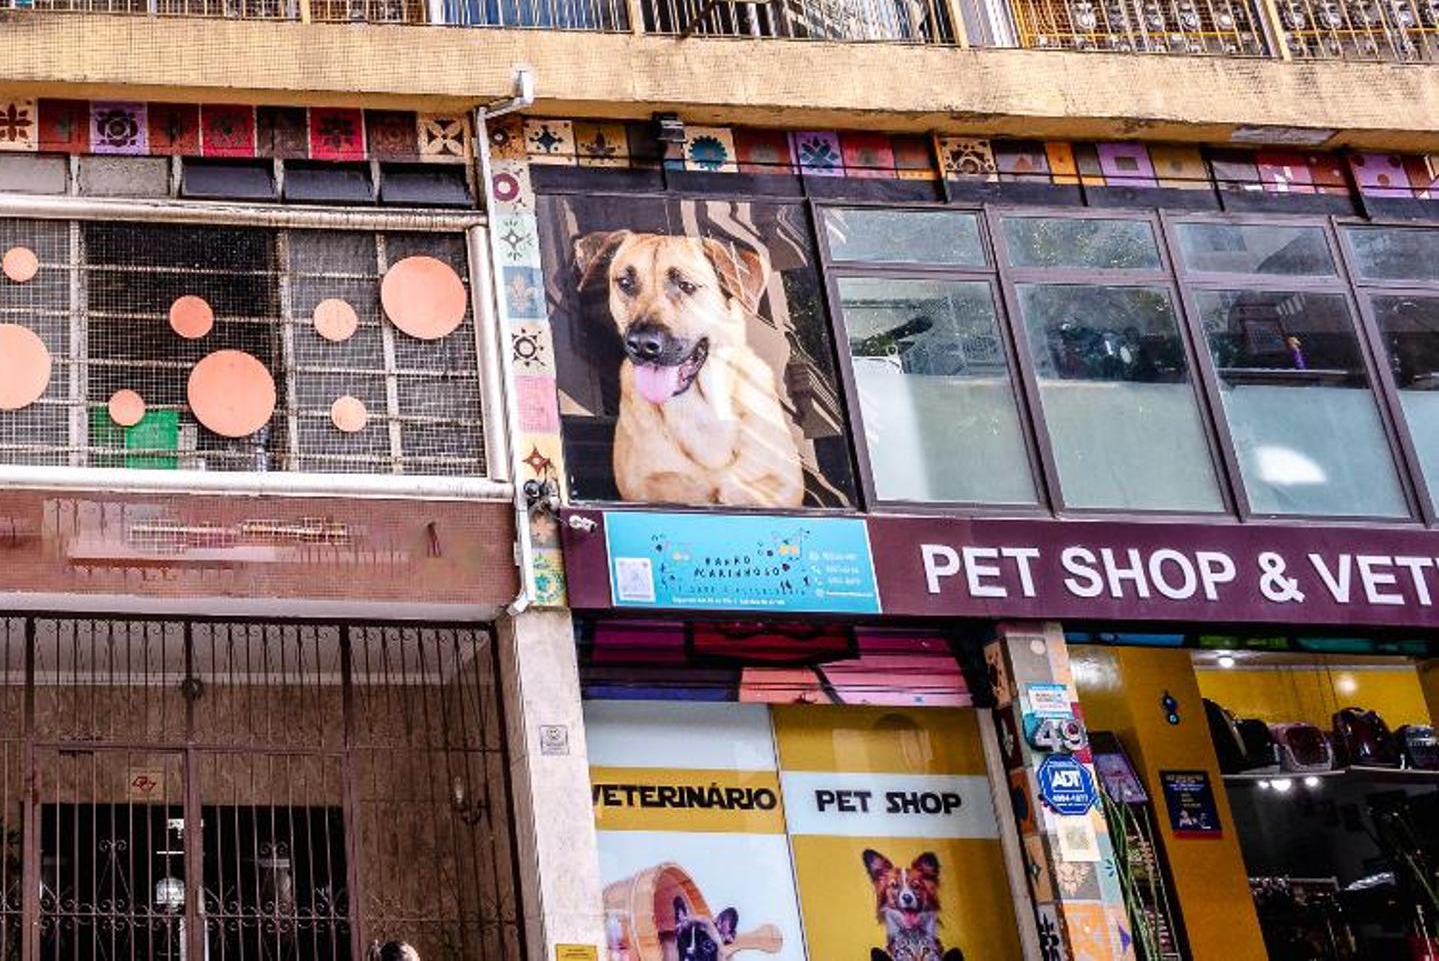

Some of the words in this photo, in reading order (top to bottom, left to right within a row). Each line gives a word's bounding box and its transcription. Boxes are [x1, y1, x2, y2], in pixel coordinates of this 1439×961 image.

[920, 544, 1040, 598] PET
[1060, 545, 1237, 601] SHOP
[1258, 551, 1305, 604] &
[1308, 553, 1439, 606] VET
[1035, 718, 1088, 752] 49
[1051, 770, 1081, 787] ADT
[815, 790, 872, 813] PET
[885, 791, 961, 815] SHOP
